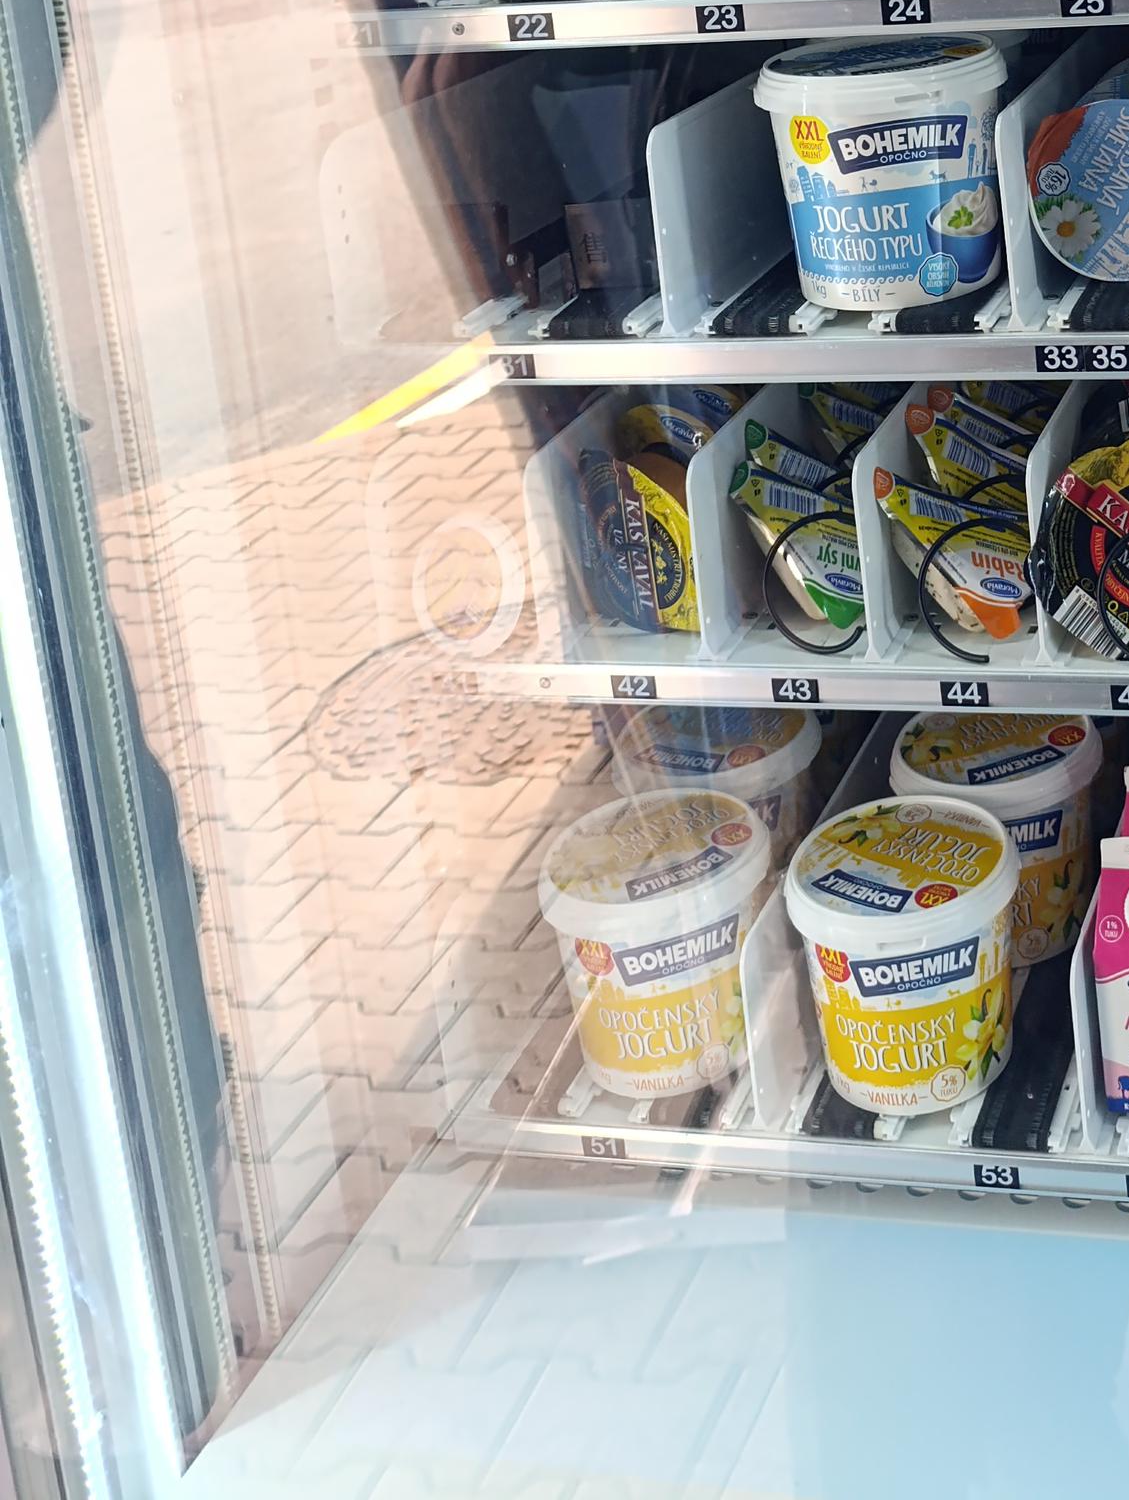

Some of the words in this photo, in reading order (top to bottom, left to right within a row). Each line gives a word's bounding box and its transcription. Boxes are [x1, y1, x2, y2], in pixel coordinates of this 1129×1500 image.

[515, 14, 549, 39] 22
[703, 5, 738, 30] 23
[794, 120, 824, 142] XXL
[838, 123, 962, 162] BOHEMILK
[879, 150, 927, 164] OPOČNO
[813, 203, 910, 233] JOGURT
[810, 231, 876, 261] ŘECKÉHO
[882, 234, 923, 260] TYPU
[1043, 346, 1079, 370] 33
[1092, 345, 1128, 369] 35
[985, 581, 1020, 596] Moravia
[617, 676, 650, 697] 42
[778, 679, 811, 700] 43
[947, 682, 982, 704] 44
[974, 749, 1058, 782] BOHEMILK
[900, 827, 991, 864] JOGURT
[633, 851, 723, 896] BOHEMILK
[821, 875, 903, 909] BOHEMILK
[622, 923, 734, 975] BOHEMILK
[858, 945, 974, 987] BOHEMILK
[897, 977, 942, 991] OPOČNO
[614, 1017, 712, 1059] JOGURT
[850, 1038, 948, 1073] JOGURT
[632, 1075, 684, 1092] VANILKA
[867, 1092, 918, 1106] VANILKA
[590, 1137, 618, 1156] 51
[981, 1164, 1013, 1186] 53
